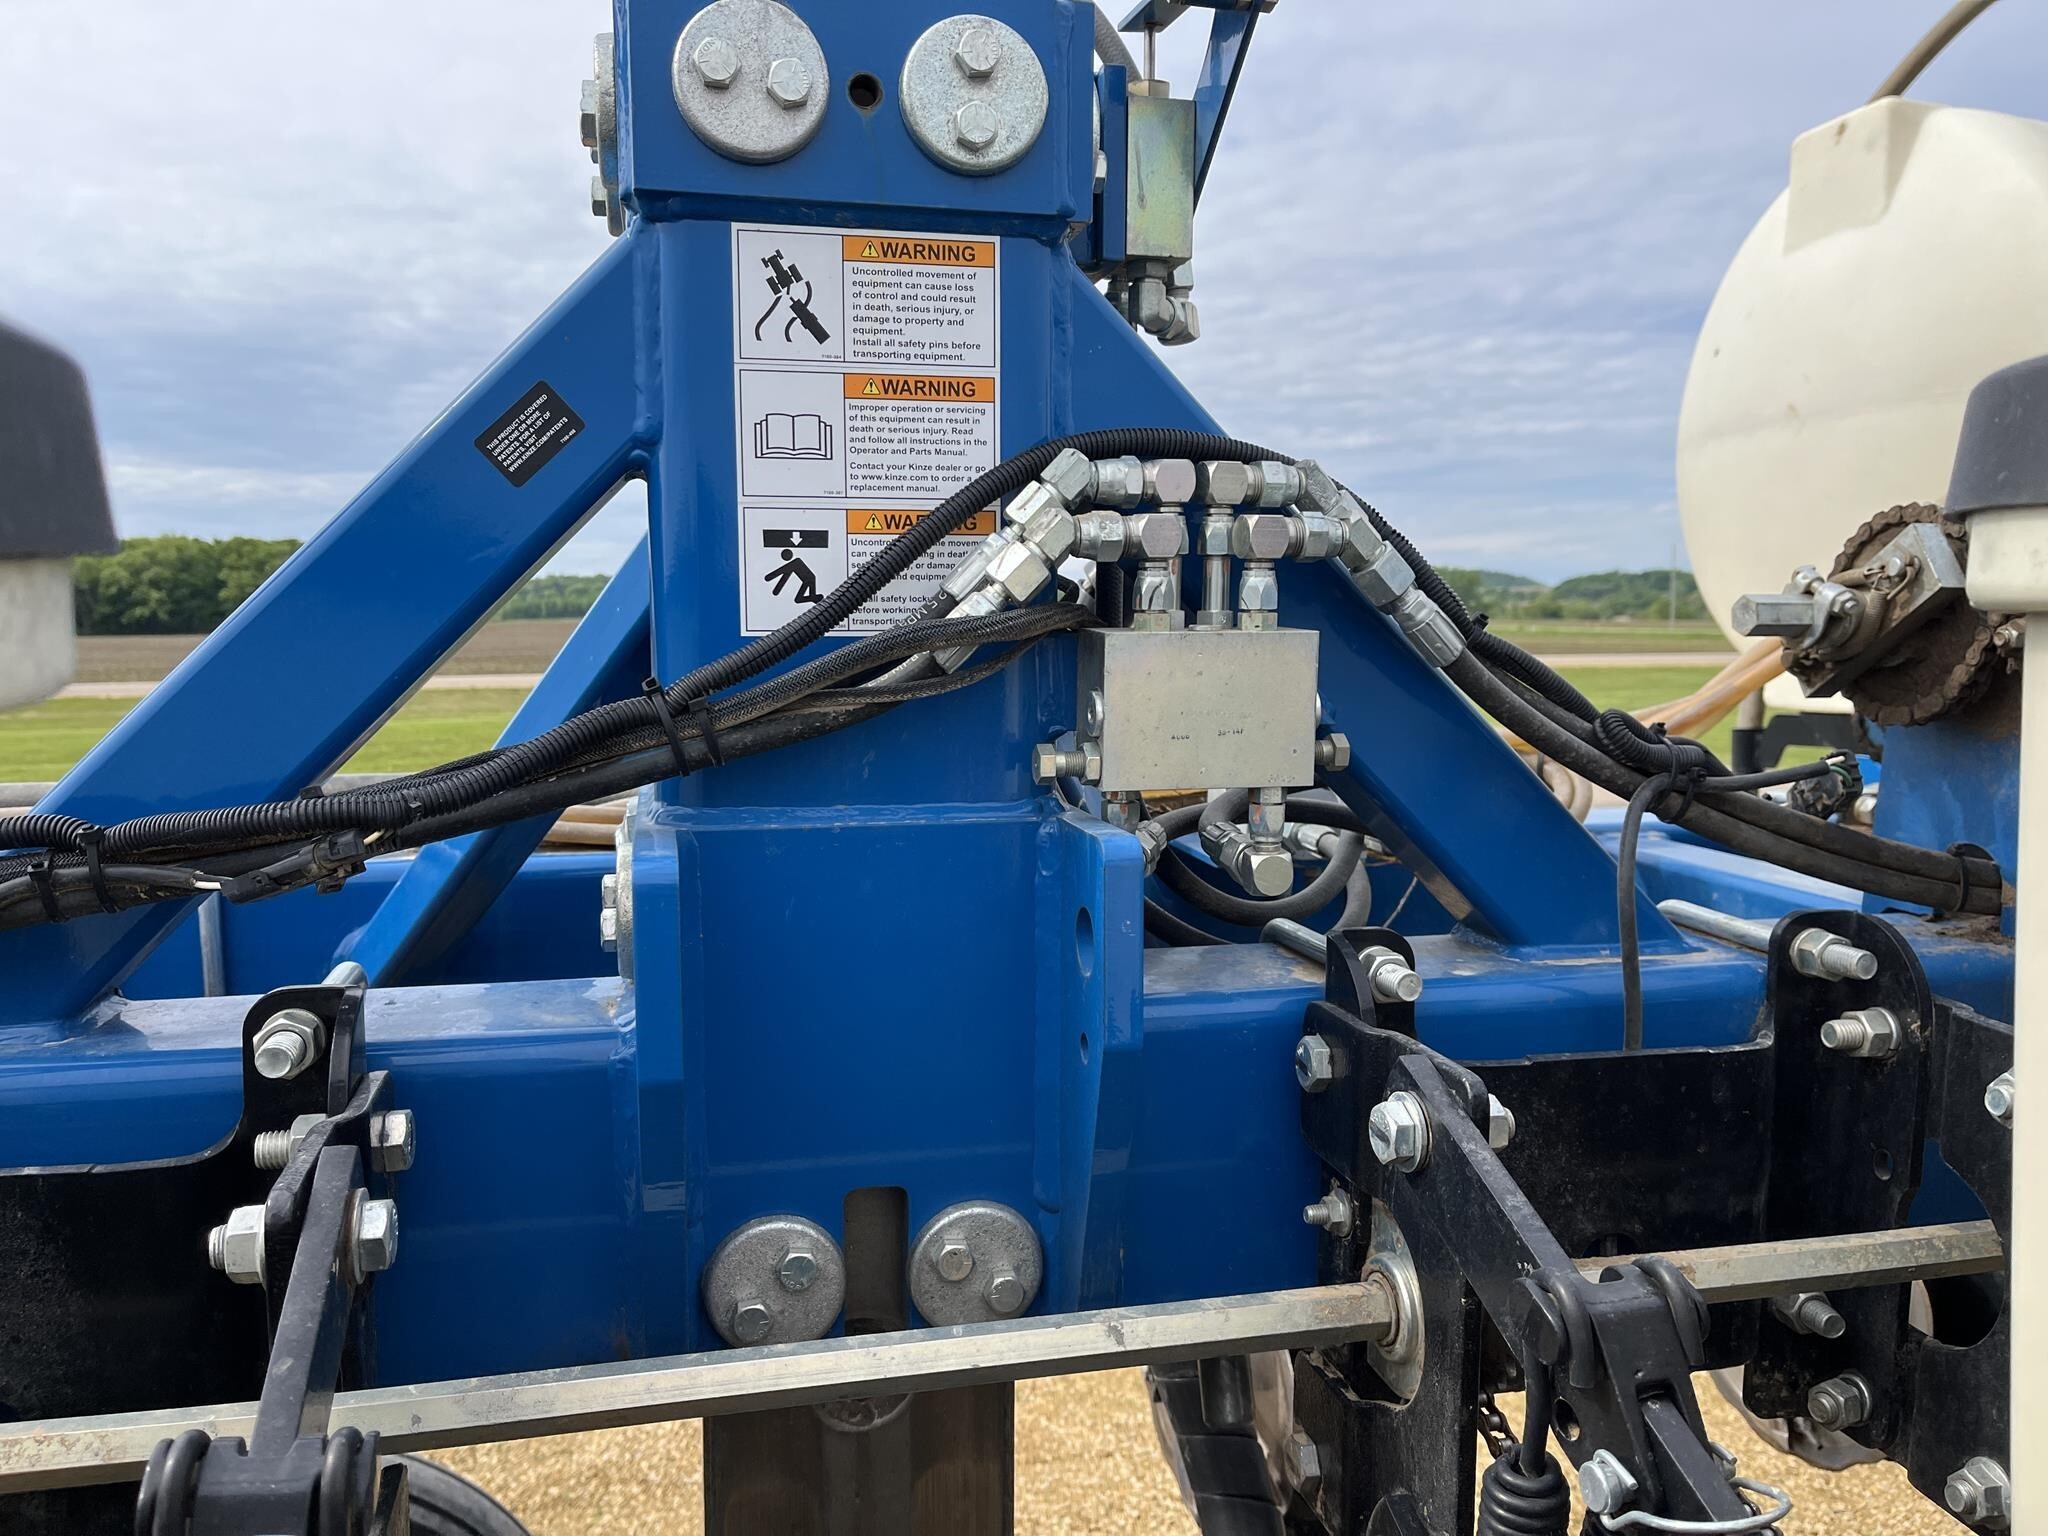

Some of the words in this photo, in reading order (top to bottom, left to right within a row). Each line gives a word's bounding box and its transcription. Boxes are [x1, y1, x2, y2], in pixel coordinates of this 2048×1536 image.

[880, 241, 975, 262] WARNING
[852, 267, 913, 277] Uncontrolled
[916, 272, 964, 280] movement
[967, 272, 976, 280] of
[852, 279, 902, 289] equipment
[955, 283, 974, 292] loss
[852, 290, 862, 298] of
[864, 292, 898, 300] control
[901, 293, 918, 301] and
[921, 294, 946, 302] could
[853, 302, 861, 310] in
[864, 303, 893, 312] death,
[896, 305, 931, 313] serious
[933, 306, 962, 316] injury,
[853, 314, 890, 325] damage
[892, 316, 902, 324] to
[905, 318, 944, 327] property
[947, 318, 964, 326] and
[852, 327, 906, 336] equipment.
[853, 338, 881, 346] Install
[884, 339, 895, 347] all
[898, 340, 926, 350] safety
[929, 341, 948, 350] pins
[952, 341, 980, 350] before
[853, 350, 911, 361] transporting
[913, 352, 966, 362] equipment.
[882, 379, 975, 397] WARNING
[849, 403, 889, 413] Improper
[891, 405, 932, 414] operation
[946, 406, 985, 416] servicing
[487, 439, 499, 450] THIS
[498, 419, 520, 441] PRODUCT
[524, 394, 547, 416] COVERED
[860, 414, 876, 422] this
[879, 415, 925, 424] equipment
[492, 439, 510, 456] UNDER
[508, 430, 520, 441] ONE
[518, 423, 528, 432] OR
[526, 411, 541, 425] MORE
[498, 441, 520, 462] PATENTS.
[519, 431, 531, 442] FOR
[533, 417, 544, 429] LIST
[543, 411, 550, 420] OF
[888, 426, 920, 434] serious
[923, 427, 949, 436] injury.
[951, 427, 973, 435] Read
[508, 417, 568, 472] WWW.KINZE.COM/PATENTS
[868, 436, 895, 444] follow
[910, 437, 961, 445] instructions
[974, 438, 987, 446] the
[503, 447, 526, 467] PATENTS,
[524, 434, 537, 447] VISIT
[849, 446, 888, 455] Operator
[934, 448, 967, 456] Manual.
[850, 462, 884, 470] Contact
[886, 464, 906, 472] your
[909, 463, 933, 471] Kinze
[975, 466, 986, 474] go
[861, 473, 928, 481] www.kinze.com
[850, 484, 904, 492] replacement
[851, 539, 894, 547] Uncontro
[927, 562, 956, 571] damag
[910, 573, 946, 582] equipme
[881, 595, 907, 604] safety
[909, 595, 931, 603] lock
[852, 618, 900, 626] transportin
